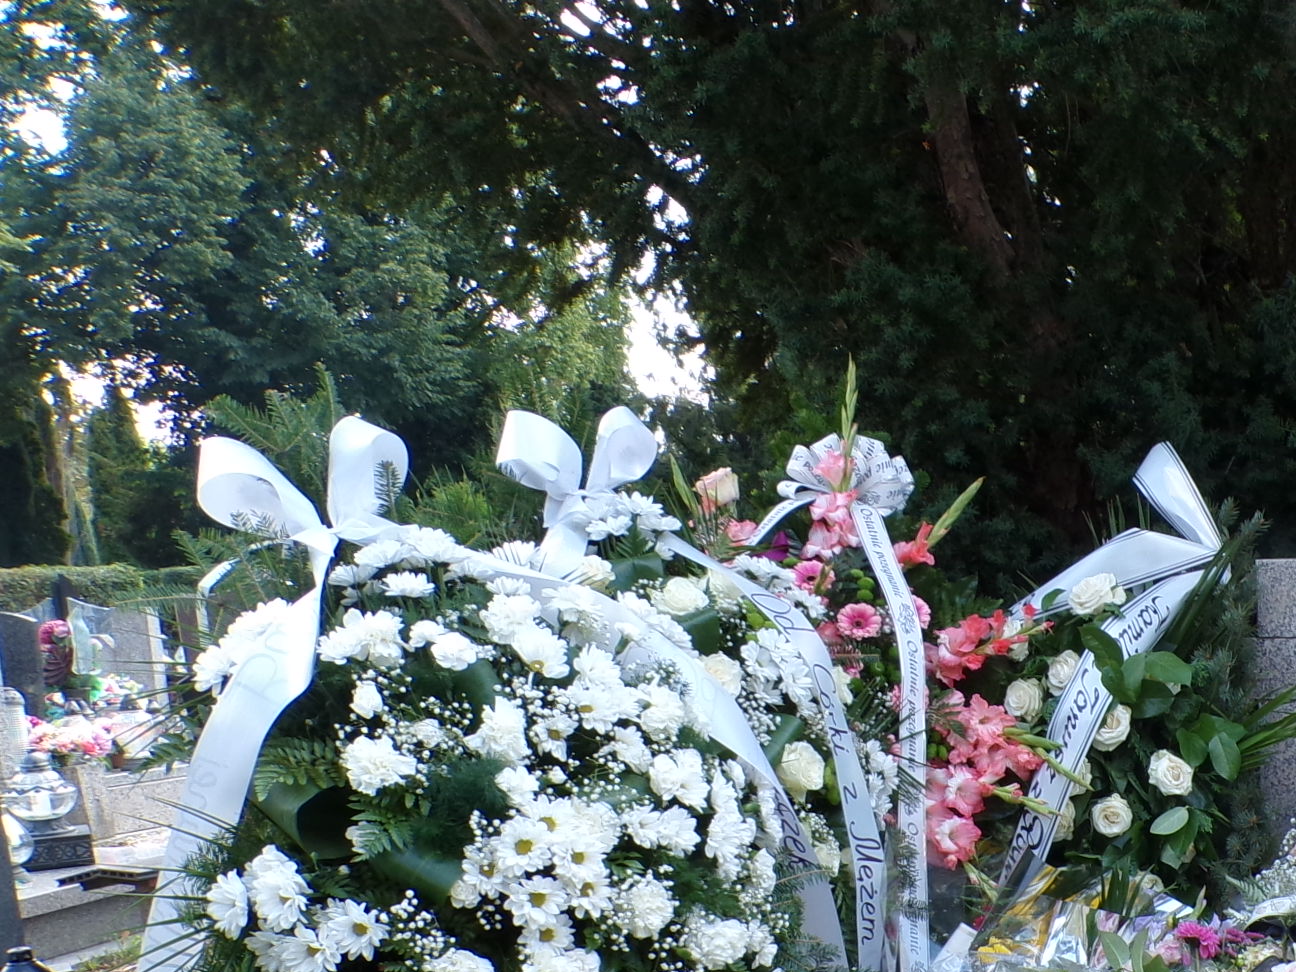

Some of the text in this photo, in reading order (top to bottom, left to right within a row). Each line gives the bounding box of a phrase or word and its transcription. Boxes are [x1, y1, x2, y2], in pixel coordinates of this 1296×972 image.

[860, 508, 880, 552] Ostatnie
[1117, 596, 1171, 657] Kamil
[907, 640, 919, 697] Ostatnie
[751, 593, 815, 643] Od
[843, 781, 858, 804] z
